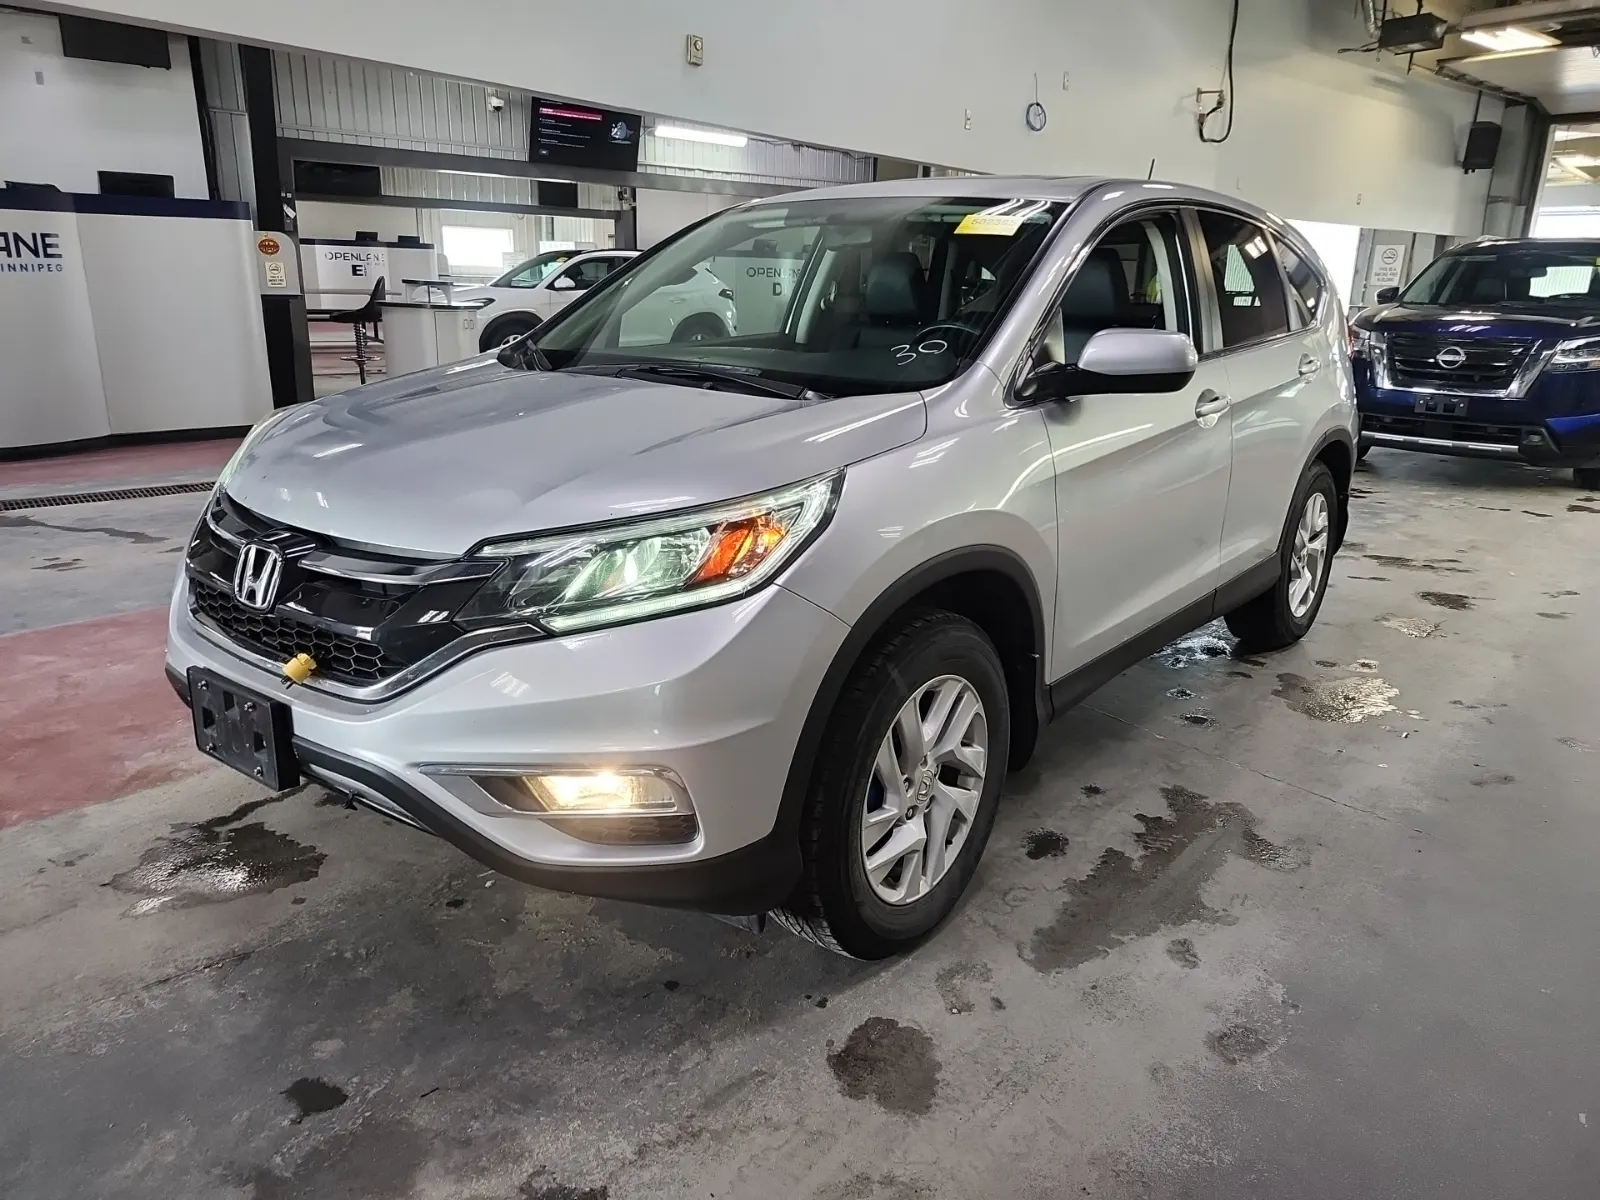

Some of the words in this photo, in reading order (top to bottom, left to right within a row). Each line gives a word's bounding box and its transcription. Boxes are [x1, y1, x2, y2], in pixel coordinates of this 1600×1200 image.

[351, 264, 364, 277] E
[772, 282, 783, 297] D
[890, 339, 948, 366] 30
